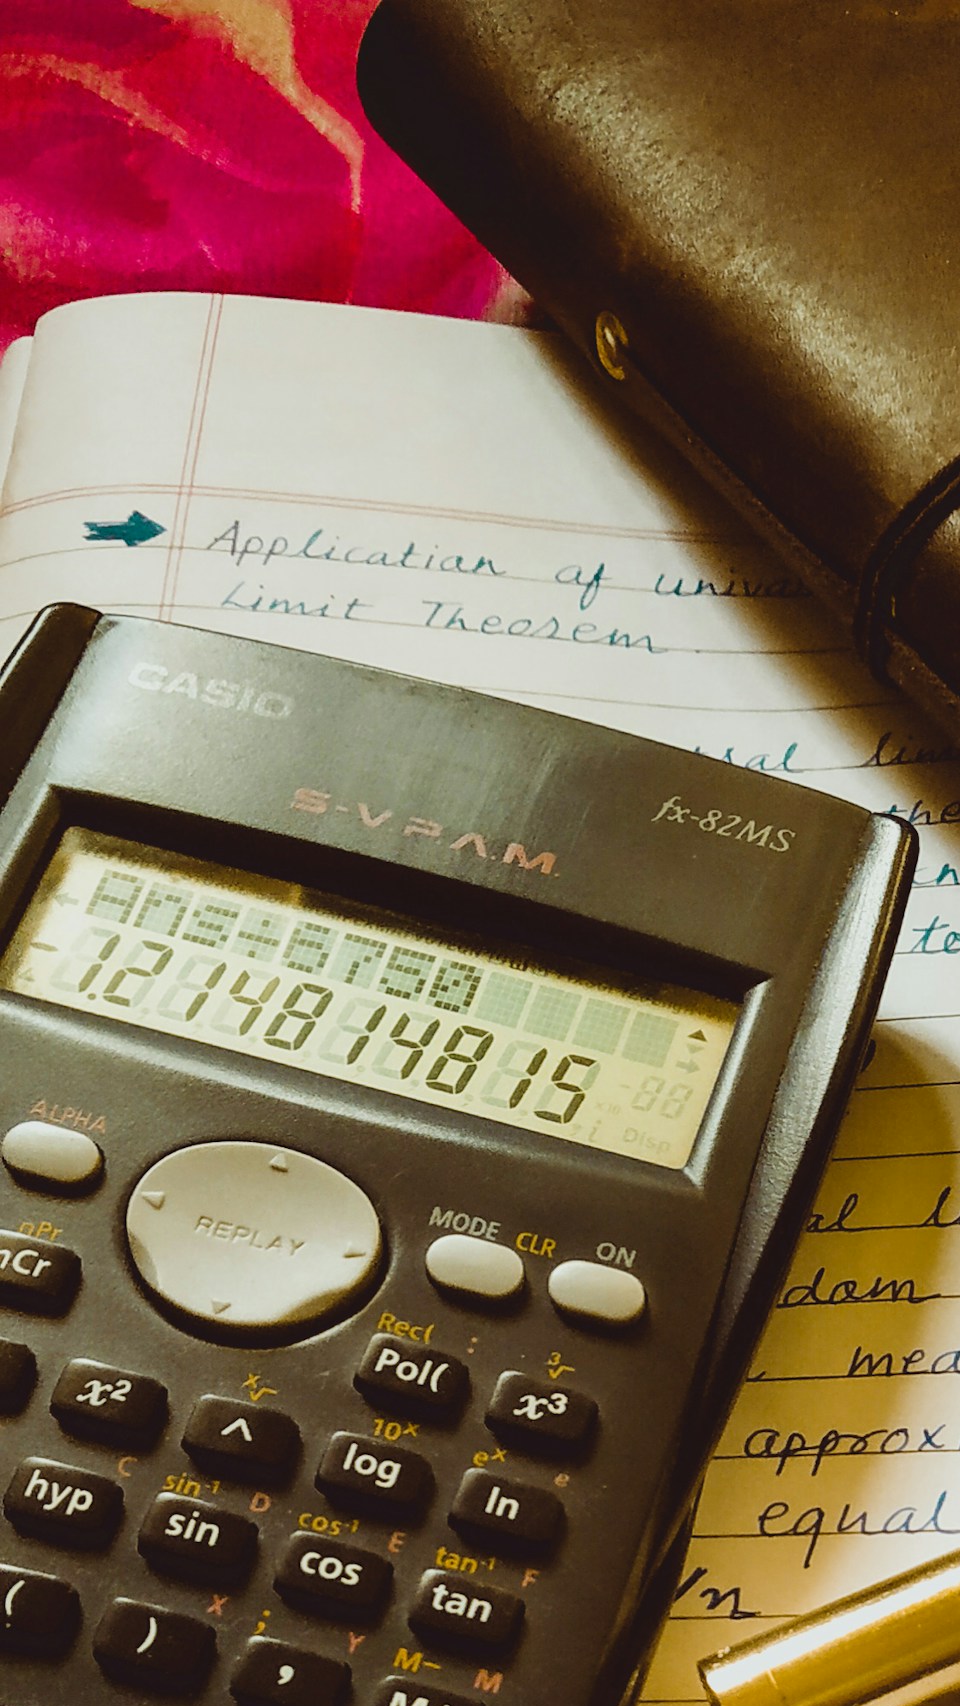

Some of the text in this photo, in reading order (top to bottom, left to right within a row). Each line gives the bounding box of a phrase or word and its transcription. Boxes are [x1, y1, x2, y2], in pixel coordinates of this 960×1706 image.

[220, 580, 374, 621] Limit
[127, 661, 295, 721] CASIO
[652, 795, 797, 857] fx-82MS
[30, 1100, 107, 1135] ALPHA
[803, 1193, 868, 1233] al
[194, 1214, 305, 1257] REPLAY
[429, 1206, 557, 1259] MODE CLR
[595, 1242, 637, 1268] ON
[772, 1267, 942, 1310] dom
[377, 1312, 435, 1344] Rec(
[374, 1348, 450, 1394] Pol(
[118, 1456, 138, 1479] C
[343, 1443, 402, 1490] log
[24, 1469, 94, 1517] hyp
[250, 1491, 272, 1514] D
[485, 1486, 520, 1521] ln
[164, 1511, 220, 1548] sin
[388, 1530, 407, 1553] E
[300, 1551, 363, 1587] cos
[521, 1567, 541, 1589] F
[4, 1579, 26, 1616] (
[207, 1594, 228, 1617] X
[431, 1582, 494, 1625] tan
[136, 1616, 158, 1655] )
[347, 1631, 367, 1656] Y
[473, 1668, 505, 1695] M
